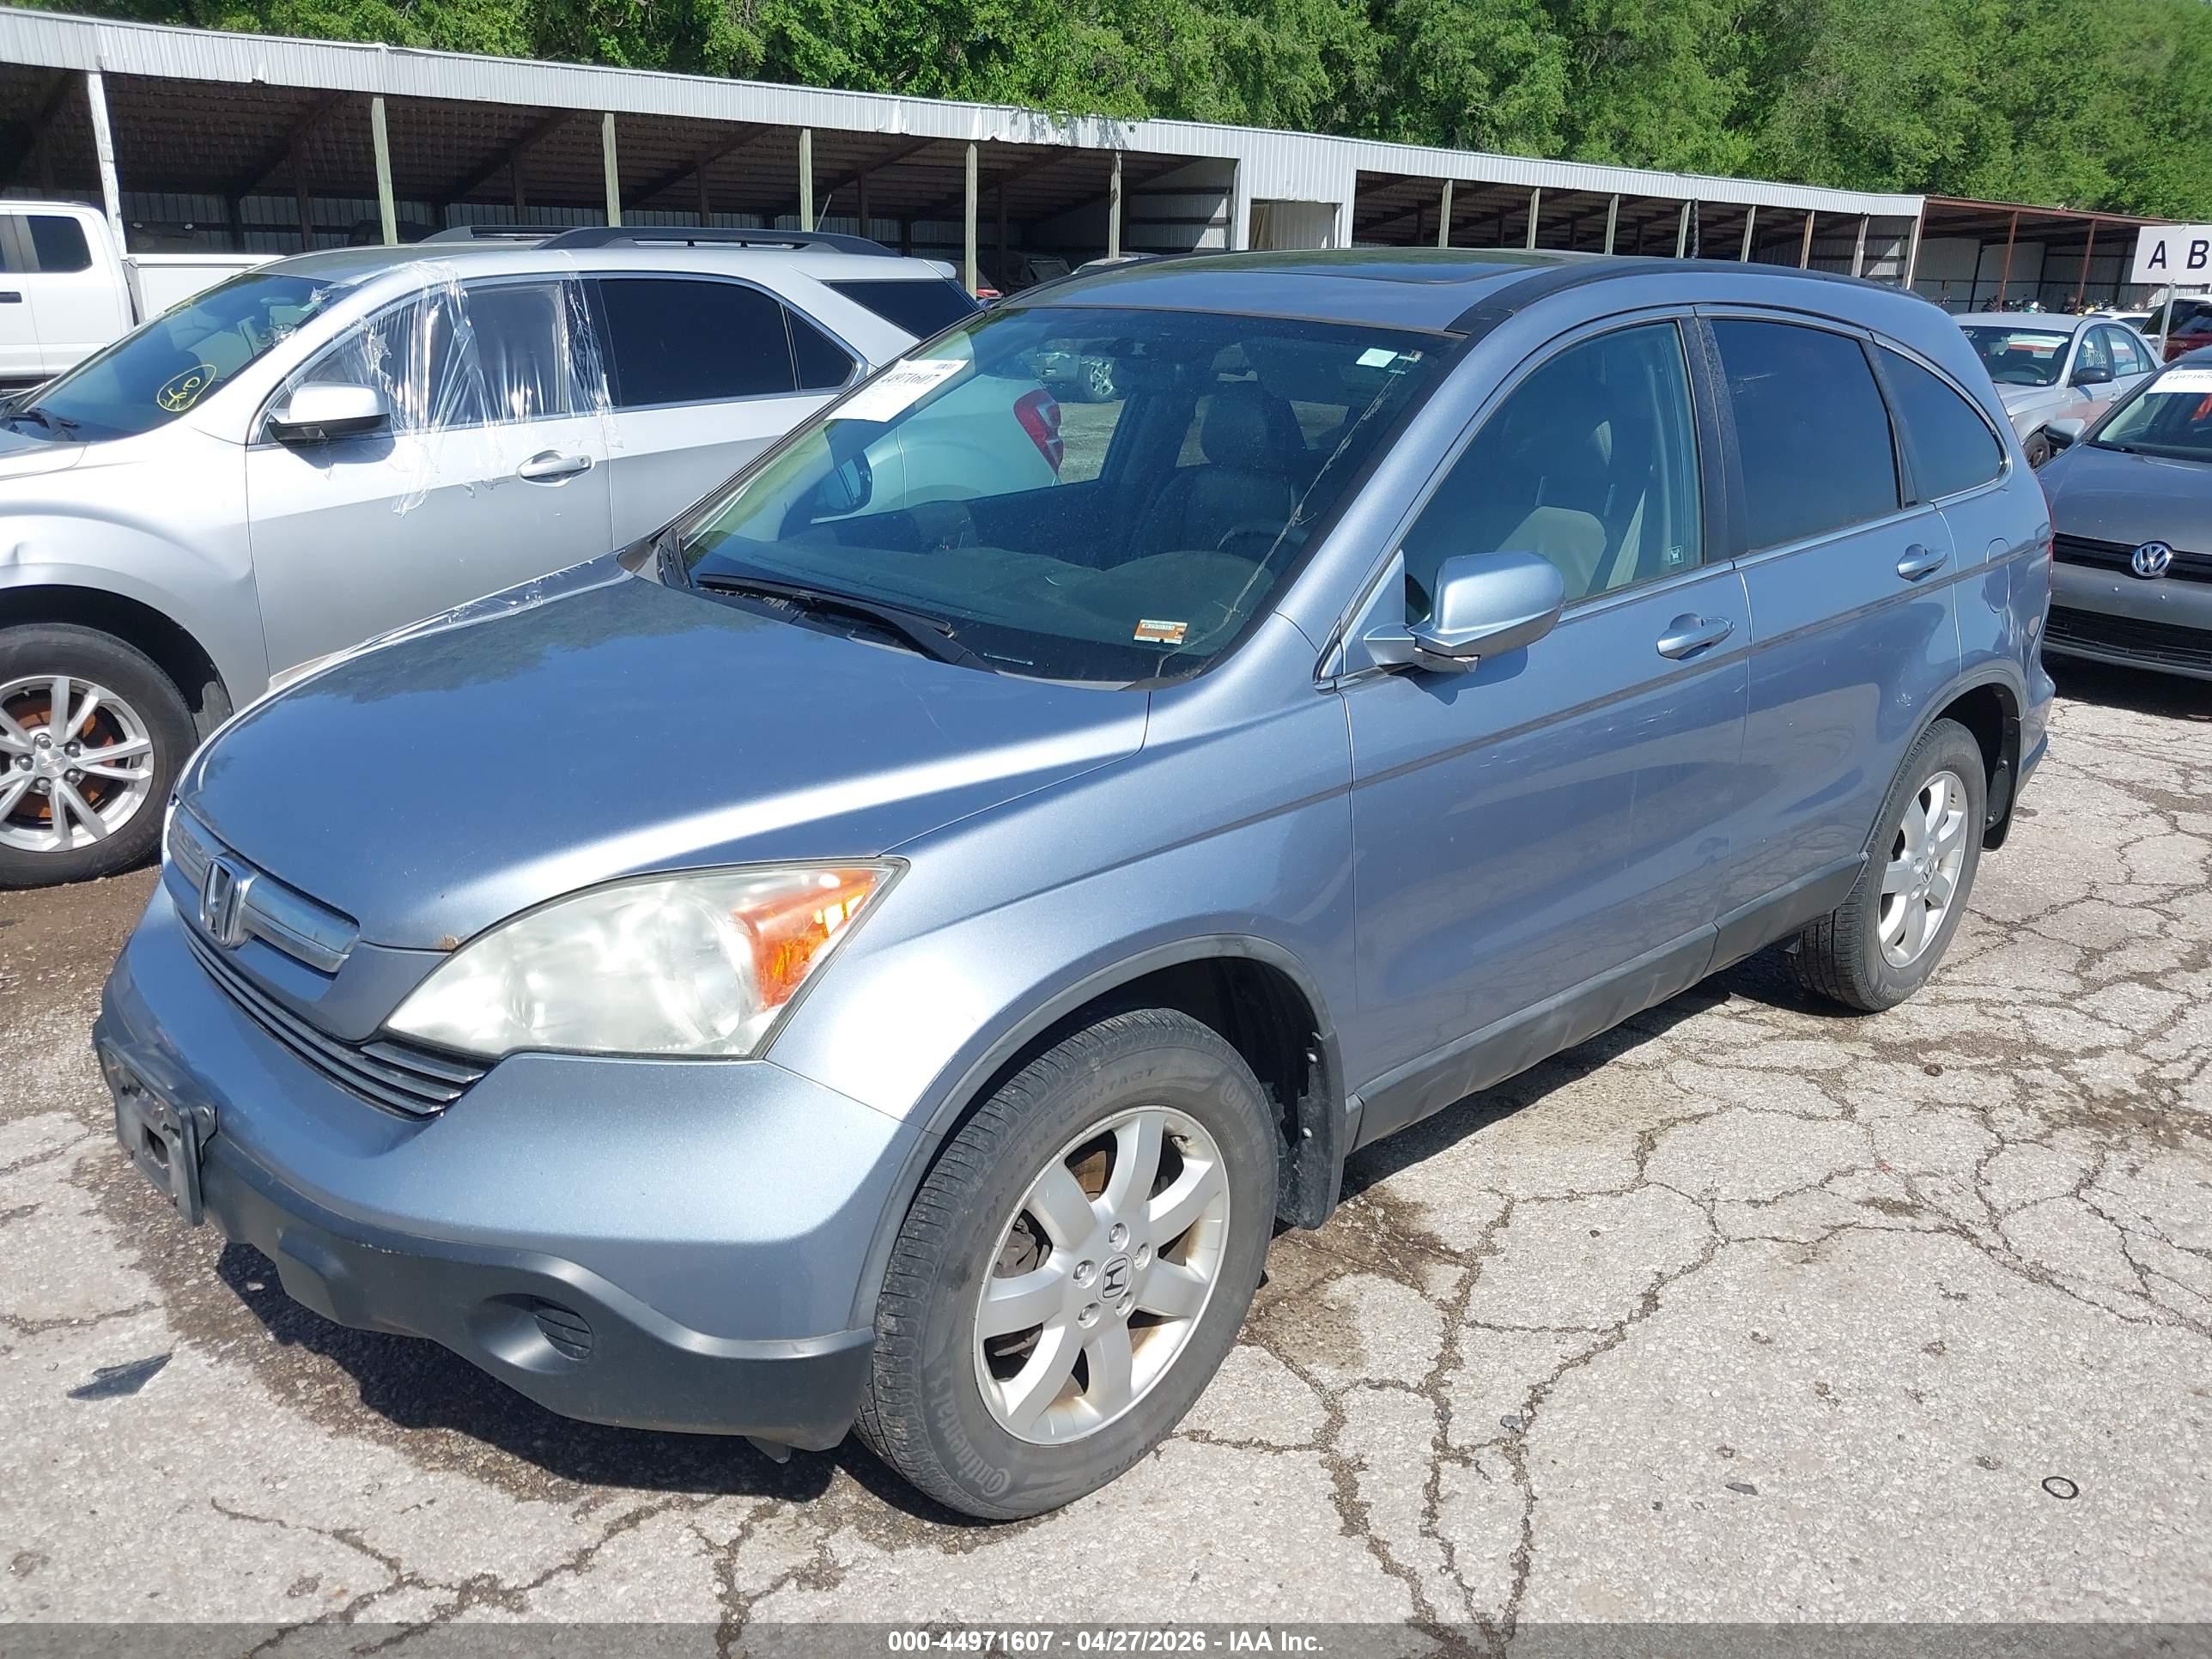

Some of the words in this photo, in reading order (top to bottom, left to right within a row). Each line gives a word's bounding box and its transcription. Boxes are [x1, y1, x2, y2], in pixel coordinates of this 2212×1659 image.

[2147, 240, 2166, 270] A
[2186, 240, 2209, 270] B
[930, 1389, 1011, 1497] Continental
